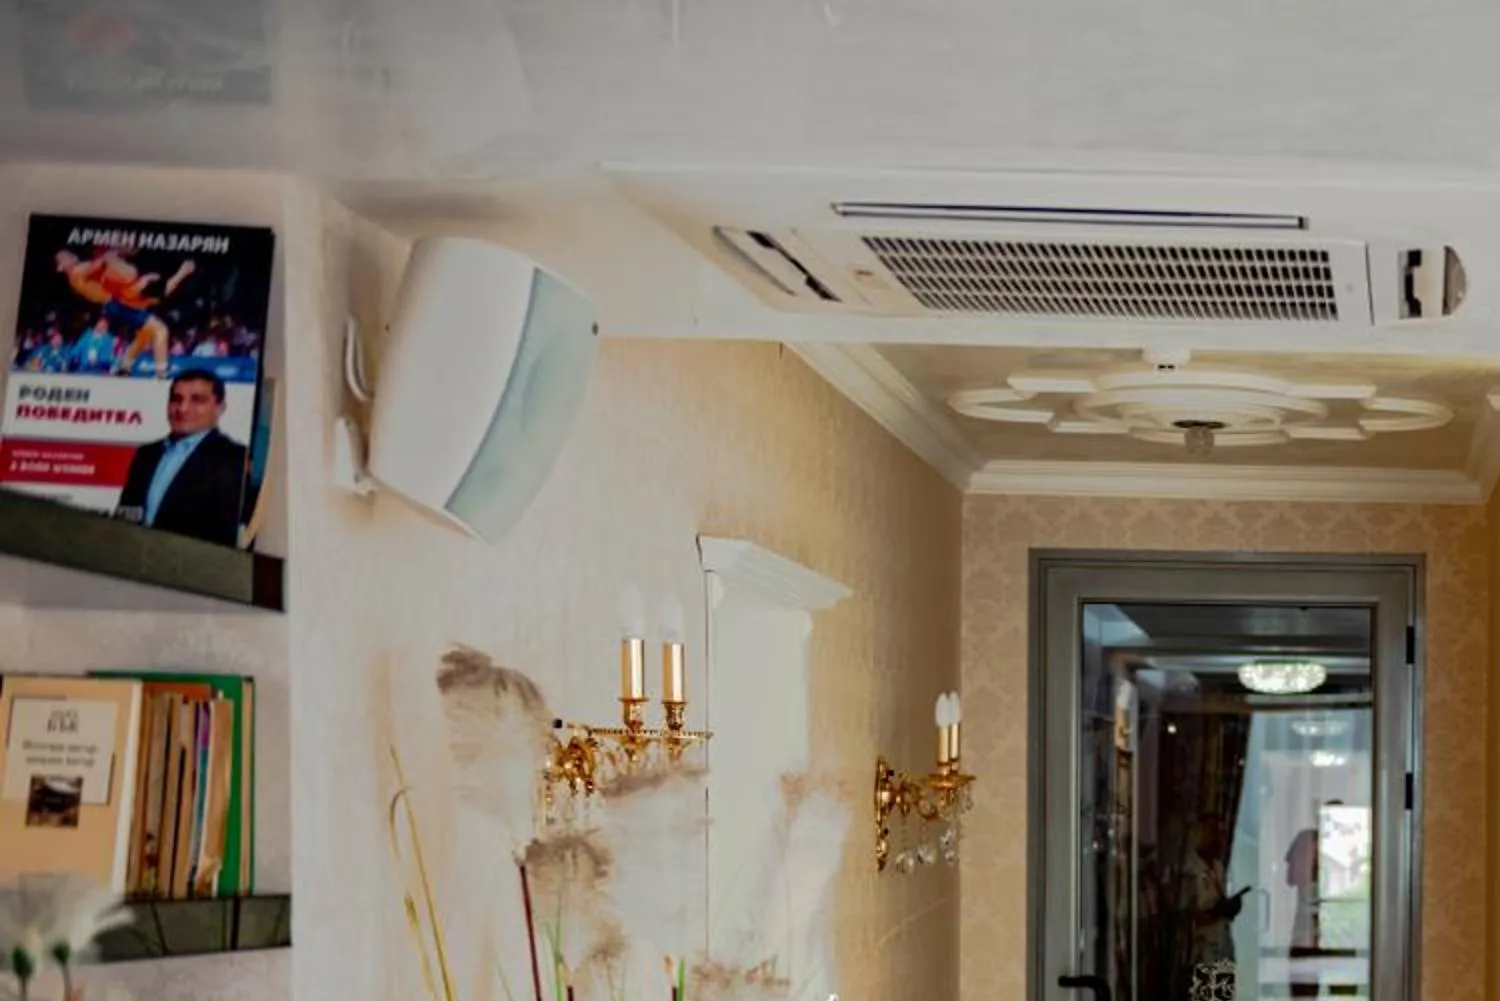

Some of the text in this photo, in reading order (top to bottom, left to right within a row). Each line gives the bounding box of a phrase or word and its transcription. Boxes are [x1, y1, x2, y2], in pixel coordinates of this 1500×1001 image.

[67, 227, 230, 254] АРМЕН НАЗАРЯН
[19, 384, 91, 403] РОДЕН
[15, 403, 142, 425] ПОБЕДИТЕЛ
